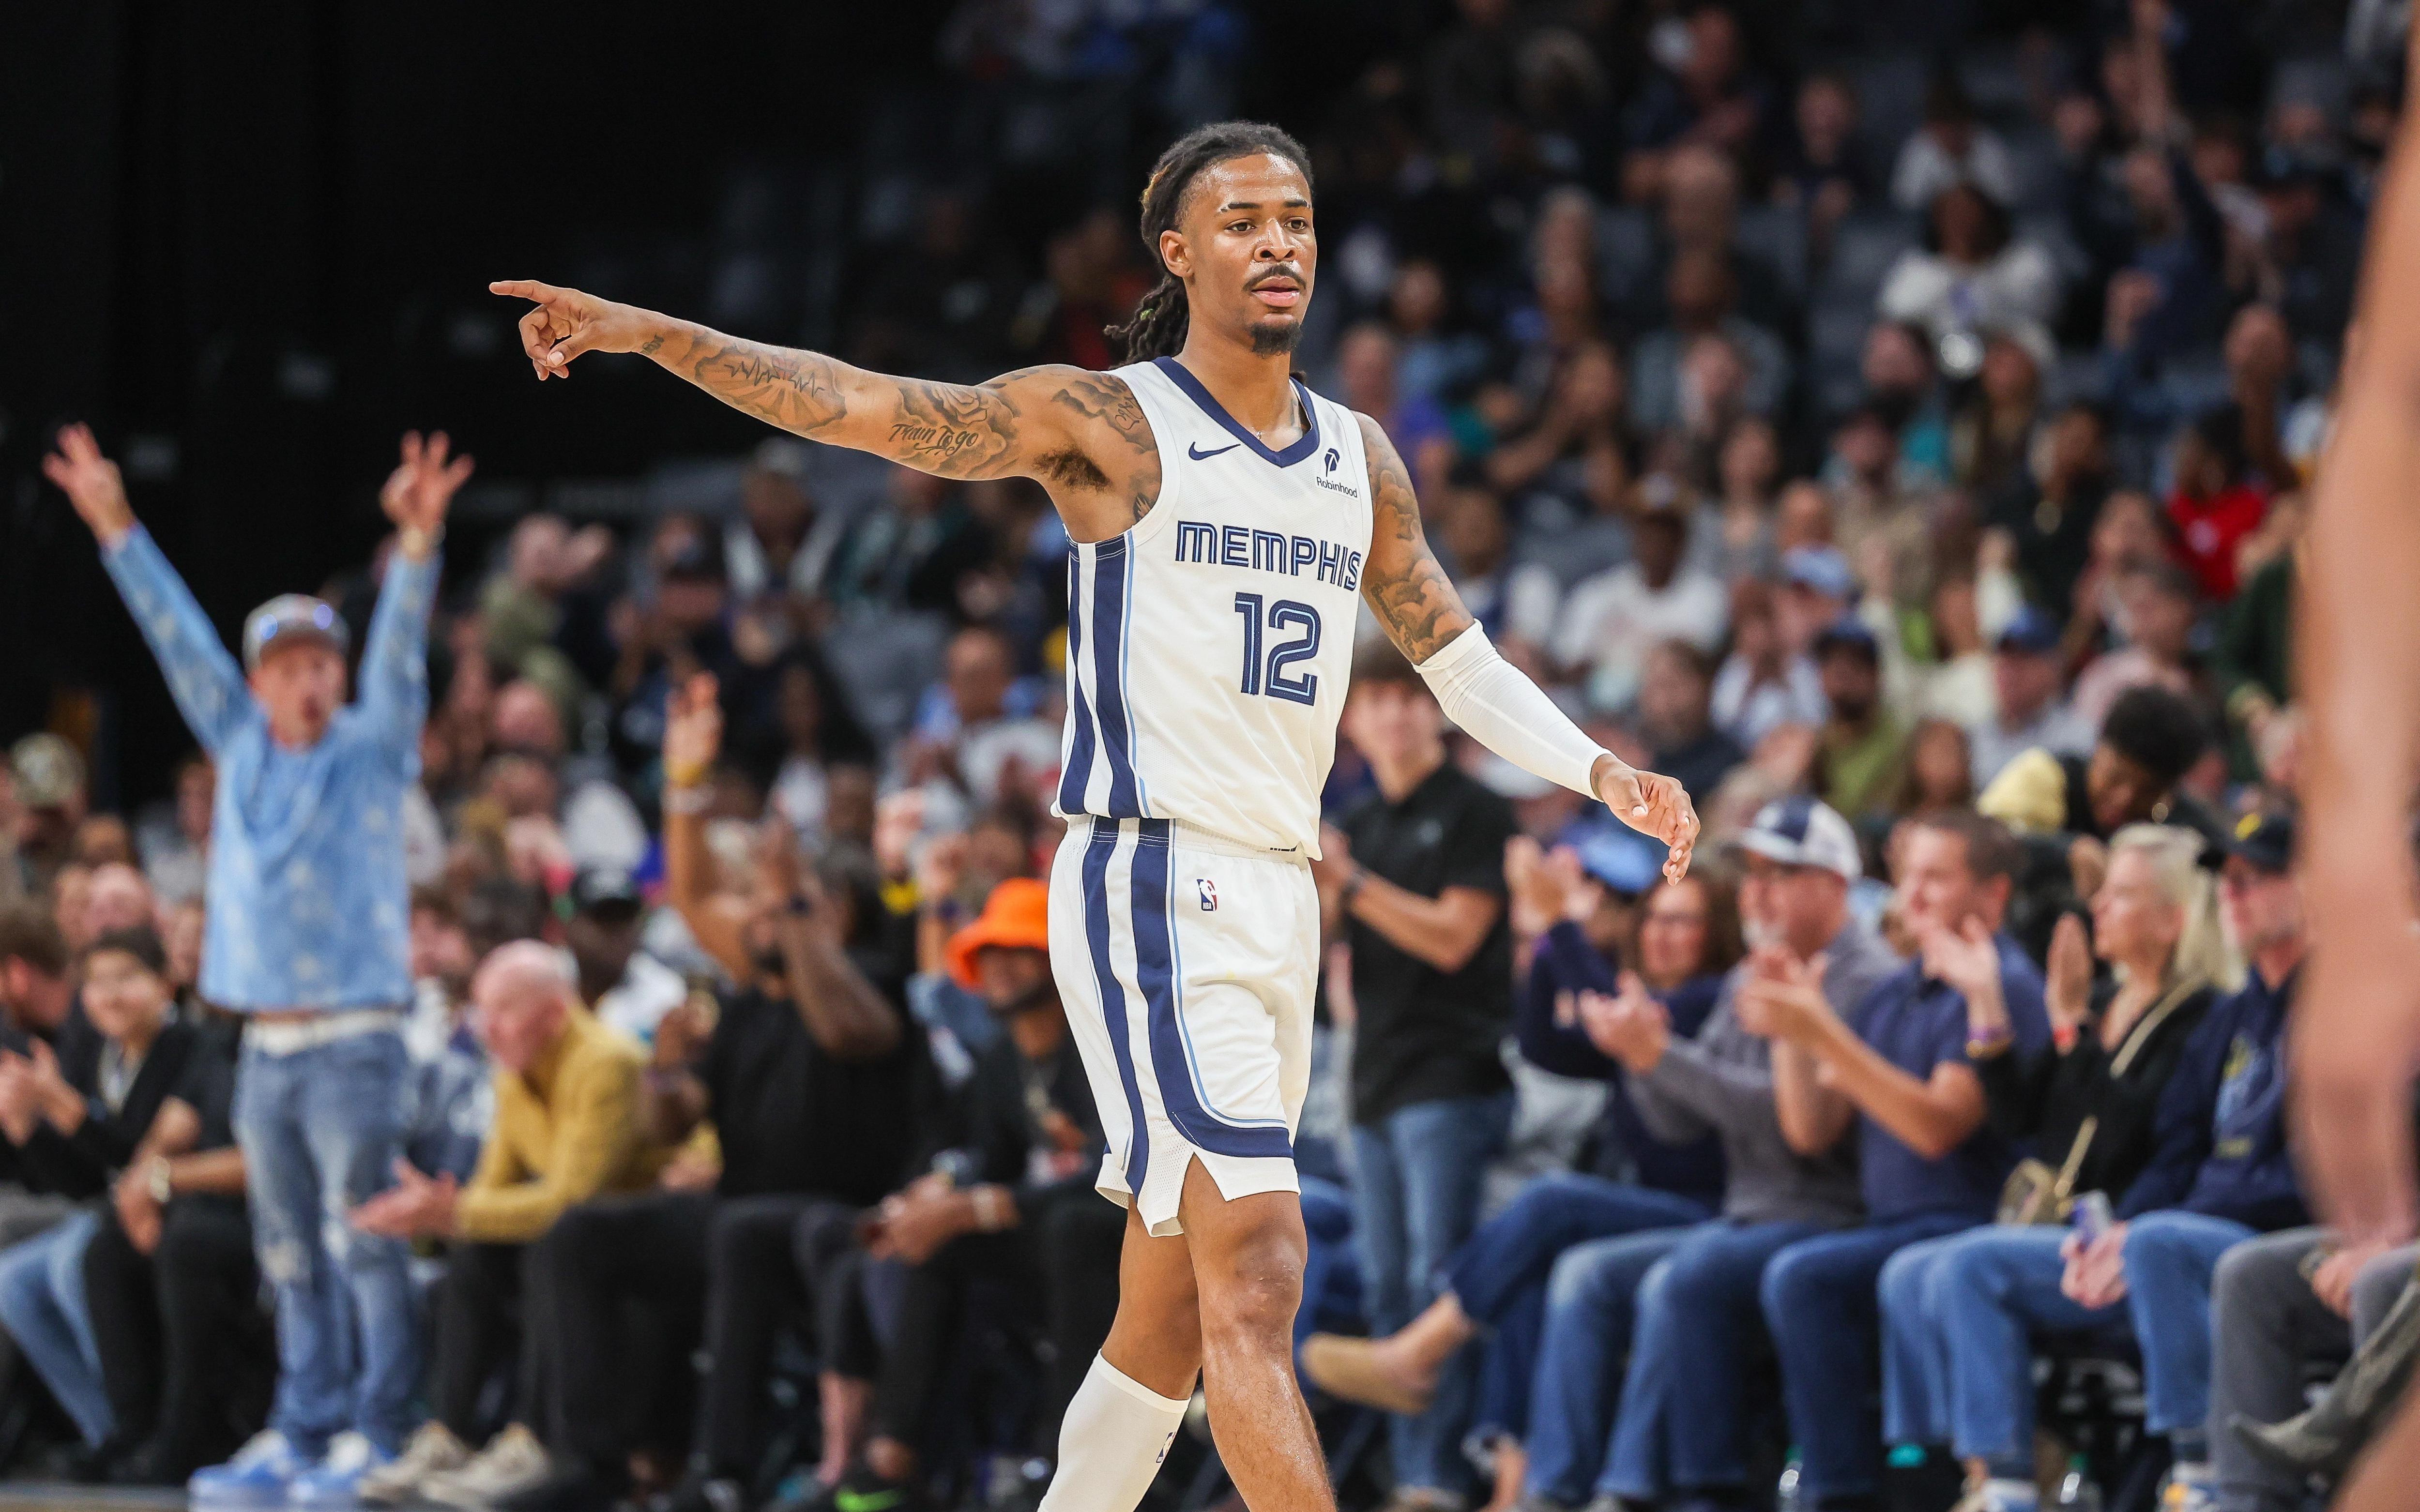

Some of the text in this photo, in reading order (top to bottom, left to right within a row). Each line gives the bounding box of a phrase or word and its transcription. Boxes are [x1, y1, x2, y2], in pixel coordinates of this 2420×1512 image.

[945, 431, 979, 456] go
[1316, 476, 1357, 498] Robinhood
[1175, 520, 1361, 592] MEMPHIS
[1234, 591, 1322, 707] 12
